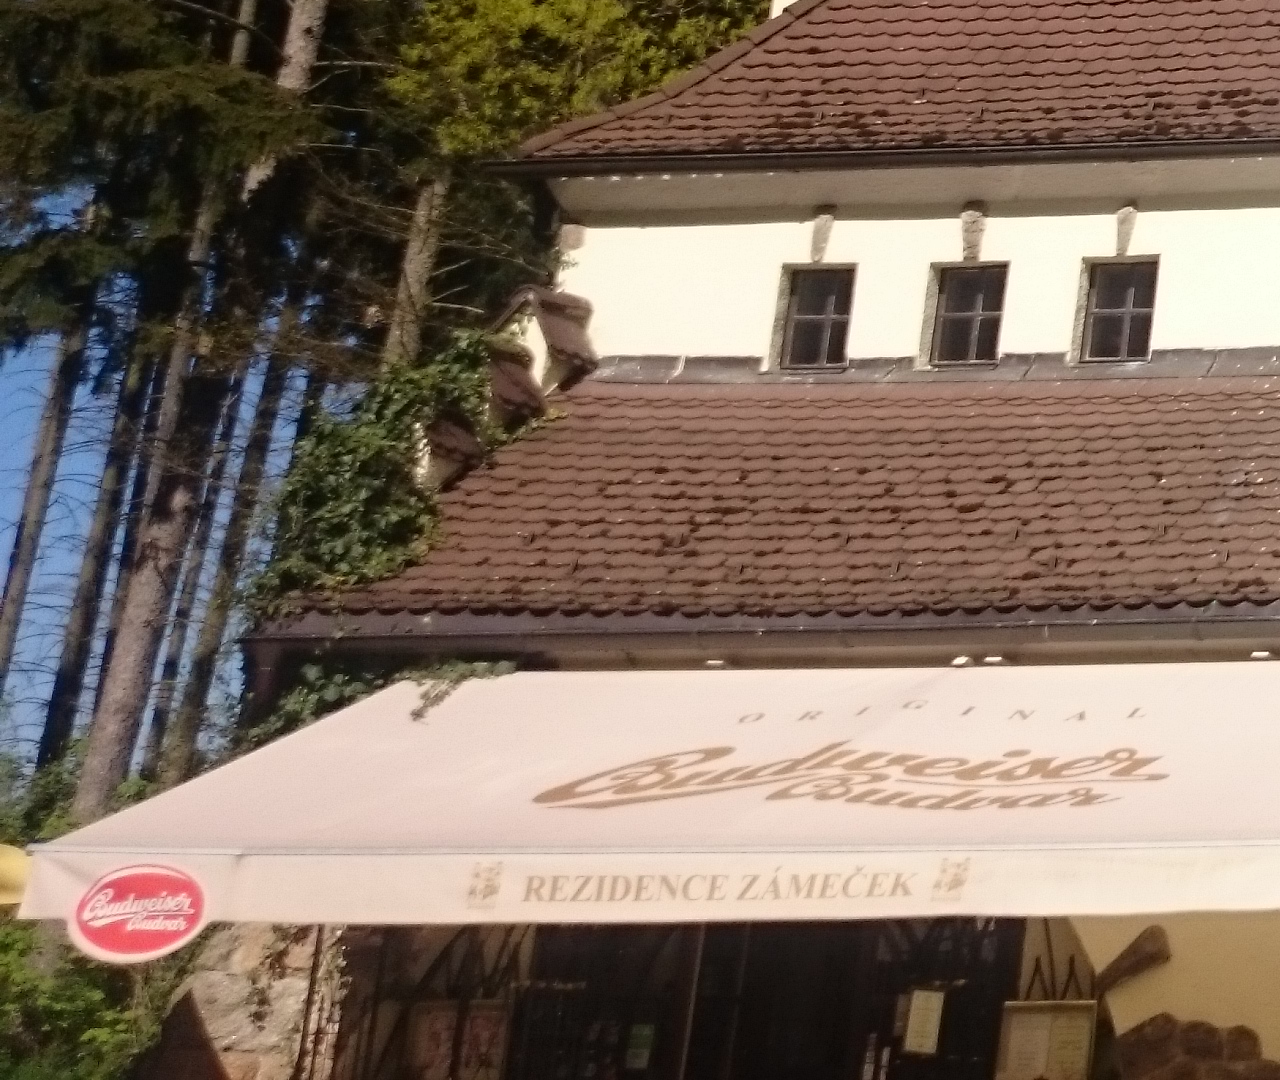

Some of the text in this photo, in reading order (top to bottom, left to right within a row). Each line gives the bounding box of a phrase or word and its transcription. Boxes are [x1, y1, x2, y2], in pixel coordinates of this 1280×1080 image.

[738, 700, 1148, 723] ORIGINAL
[532, 739, 1170, 808] Budweiser
[765, 772, 1123, 810] Budvar
[522, 865, 919, 902] REZIDENCE ZÁMEČEK
[83, 888, 196, 925] Budweiser
[126, 912, 188, 931] Budvar
